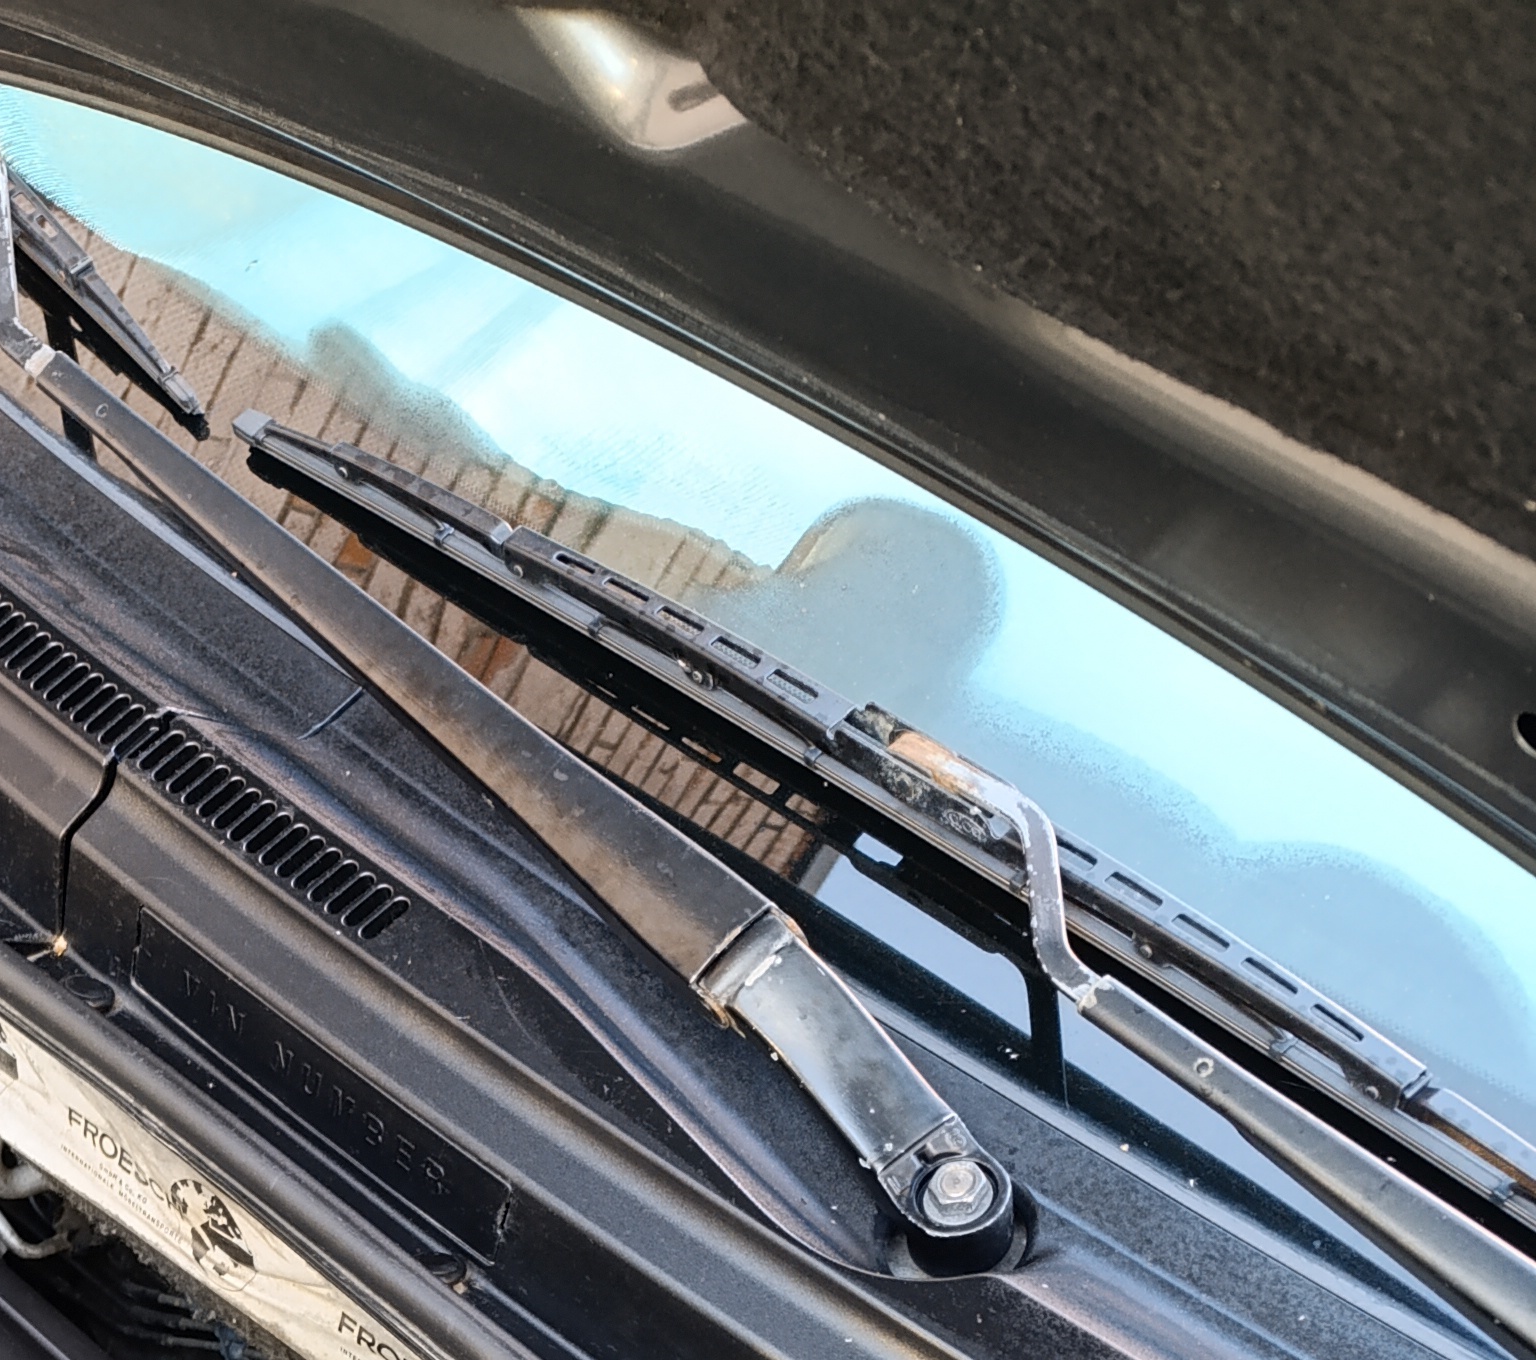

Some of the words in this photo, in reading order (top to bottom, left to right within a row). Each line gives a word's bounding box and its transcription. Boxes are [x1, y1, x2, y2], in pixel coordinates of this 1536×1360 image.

[181, 969, 247, 1032] VIN
[273, 1041, 451, 1197] NUMBER
[59, 1143, 114, 1190] INTERNATIONALE
